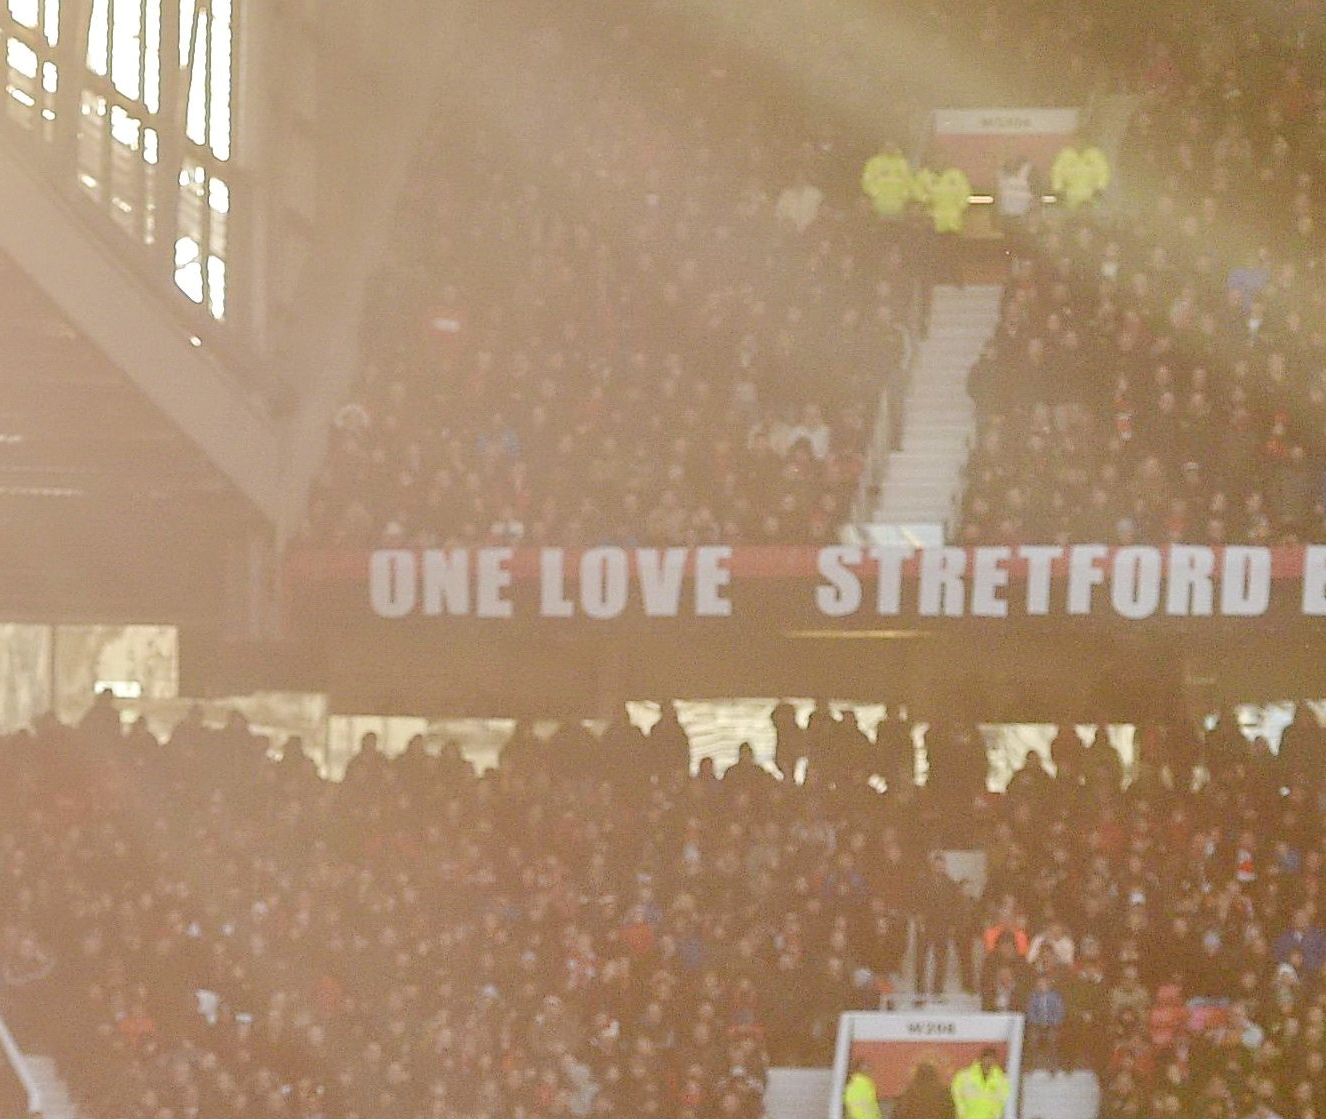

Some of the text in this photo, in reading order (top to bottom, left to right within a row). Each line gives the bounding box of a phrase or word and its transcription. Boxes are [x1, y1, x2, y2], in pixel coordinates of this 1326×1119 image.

[367, 544, 513, 618] ONE
[540, 545, 734, 618] LOVE
[815, 544, 1272, 618] STRETFORD
